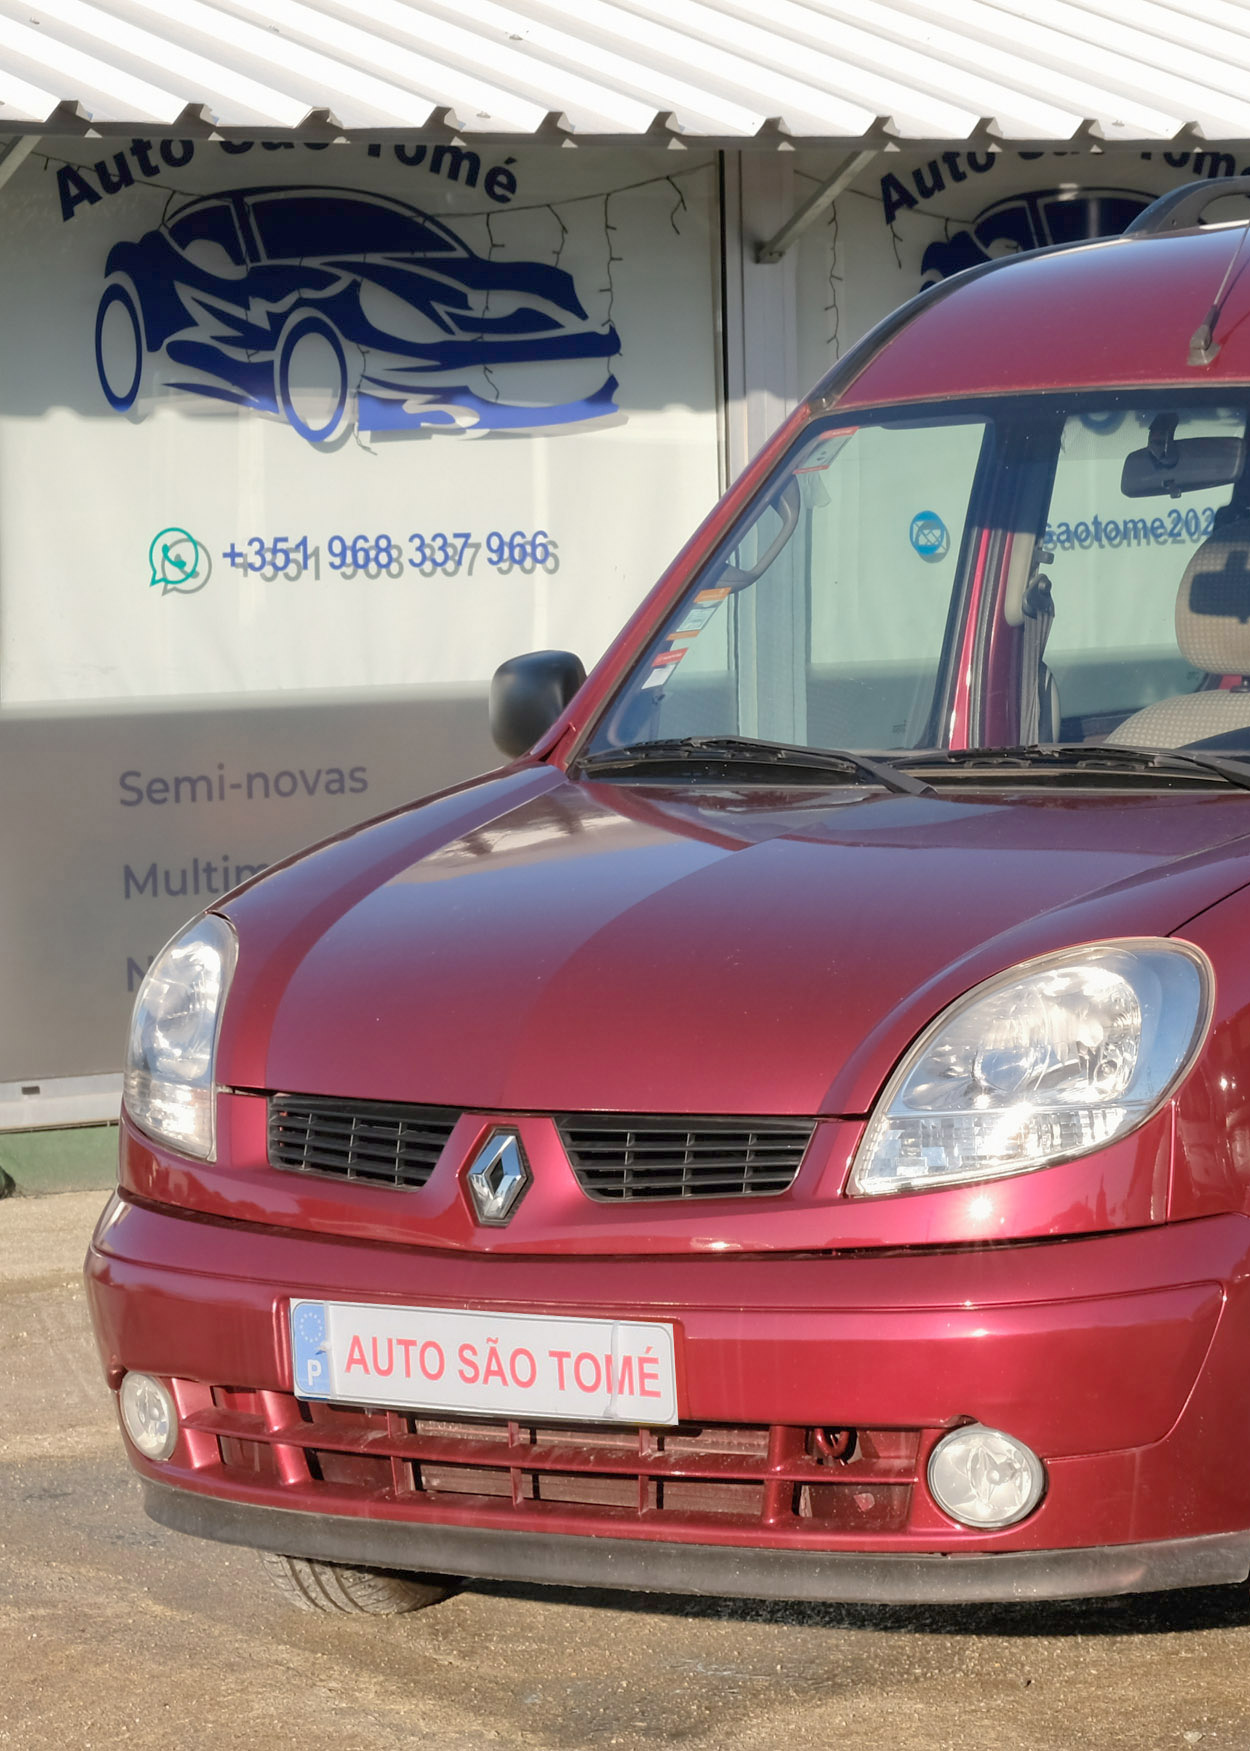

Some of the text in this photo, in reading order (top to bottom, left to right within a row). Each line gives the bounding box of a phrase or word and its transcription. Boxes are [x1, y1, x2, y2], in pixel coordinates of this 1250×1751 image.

[57, 138, 518, 222] Auto omé
[880, 152, 996, 224] Auto
[223, 530, 550, 572] +351 968 337 966
[119, 763, 368, 807] Semi-novas
[306, 1359, 322, 1386] P
[345, 1335, 662, 1398] AUTO SÃO TOMÉ
